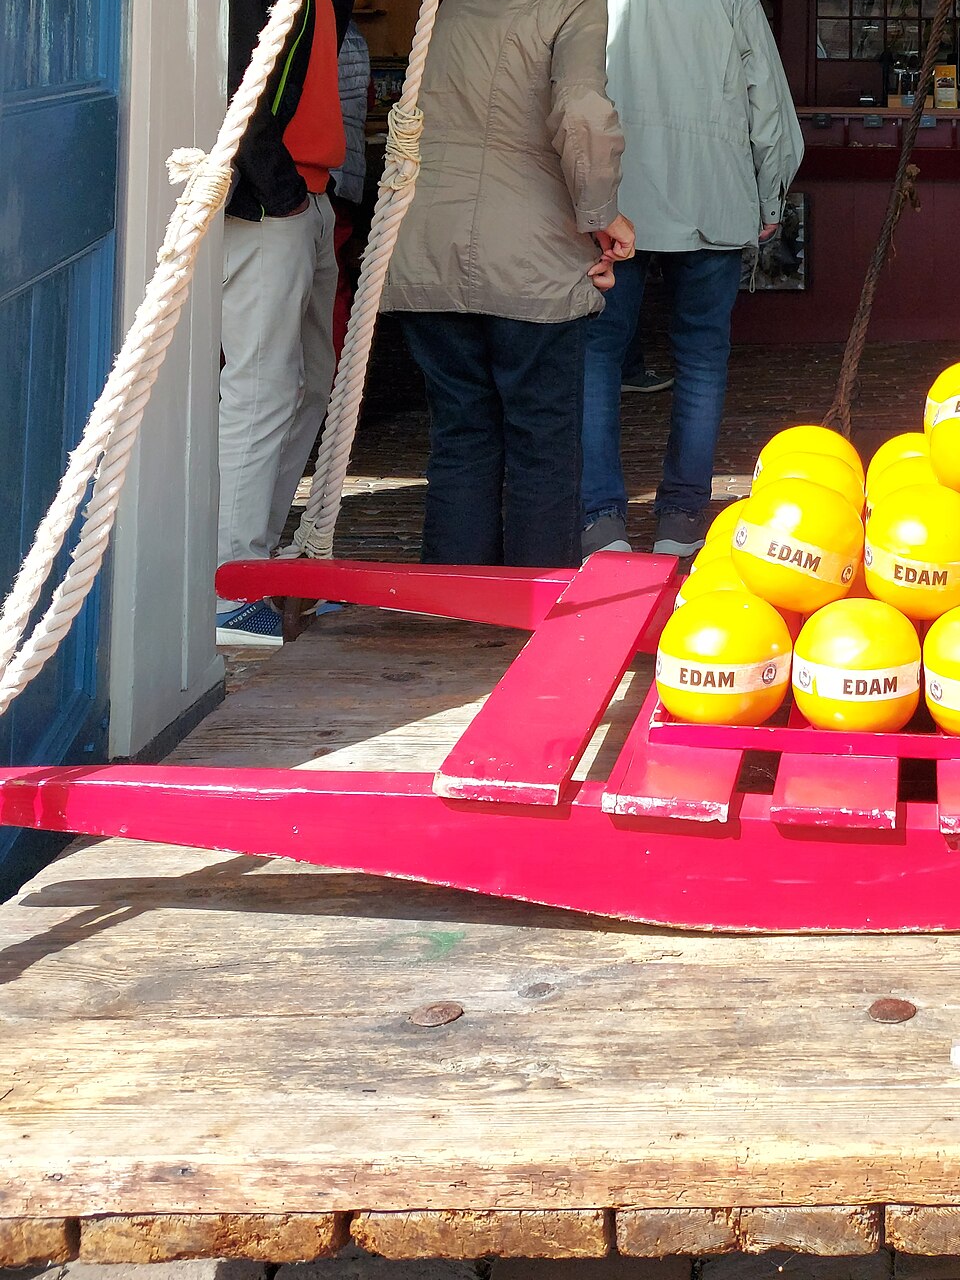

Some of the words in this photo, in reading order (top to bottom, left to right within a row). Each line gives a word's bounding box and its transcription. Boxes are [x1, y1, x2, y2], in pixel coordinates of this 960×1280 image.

[766, 540, 822, 573] EDAM
[893, 563, 948, 586] EDAM
[679, 667, 735, 688] EDAM
[843, 676, 898, 696] EDAM
